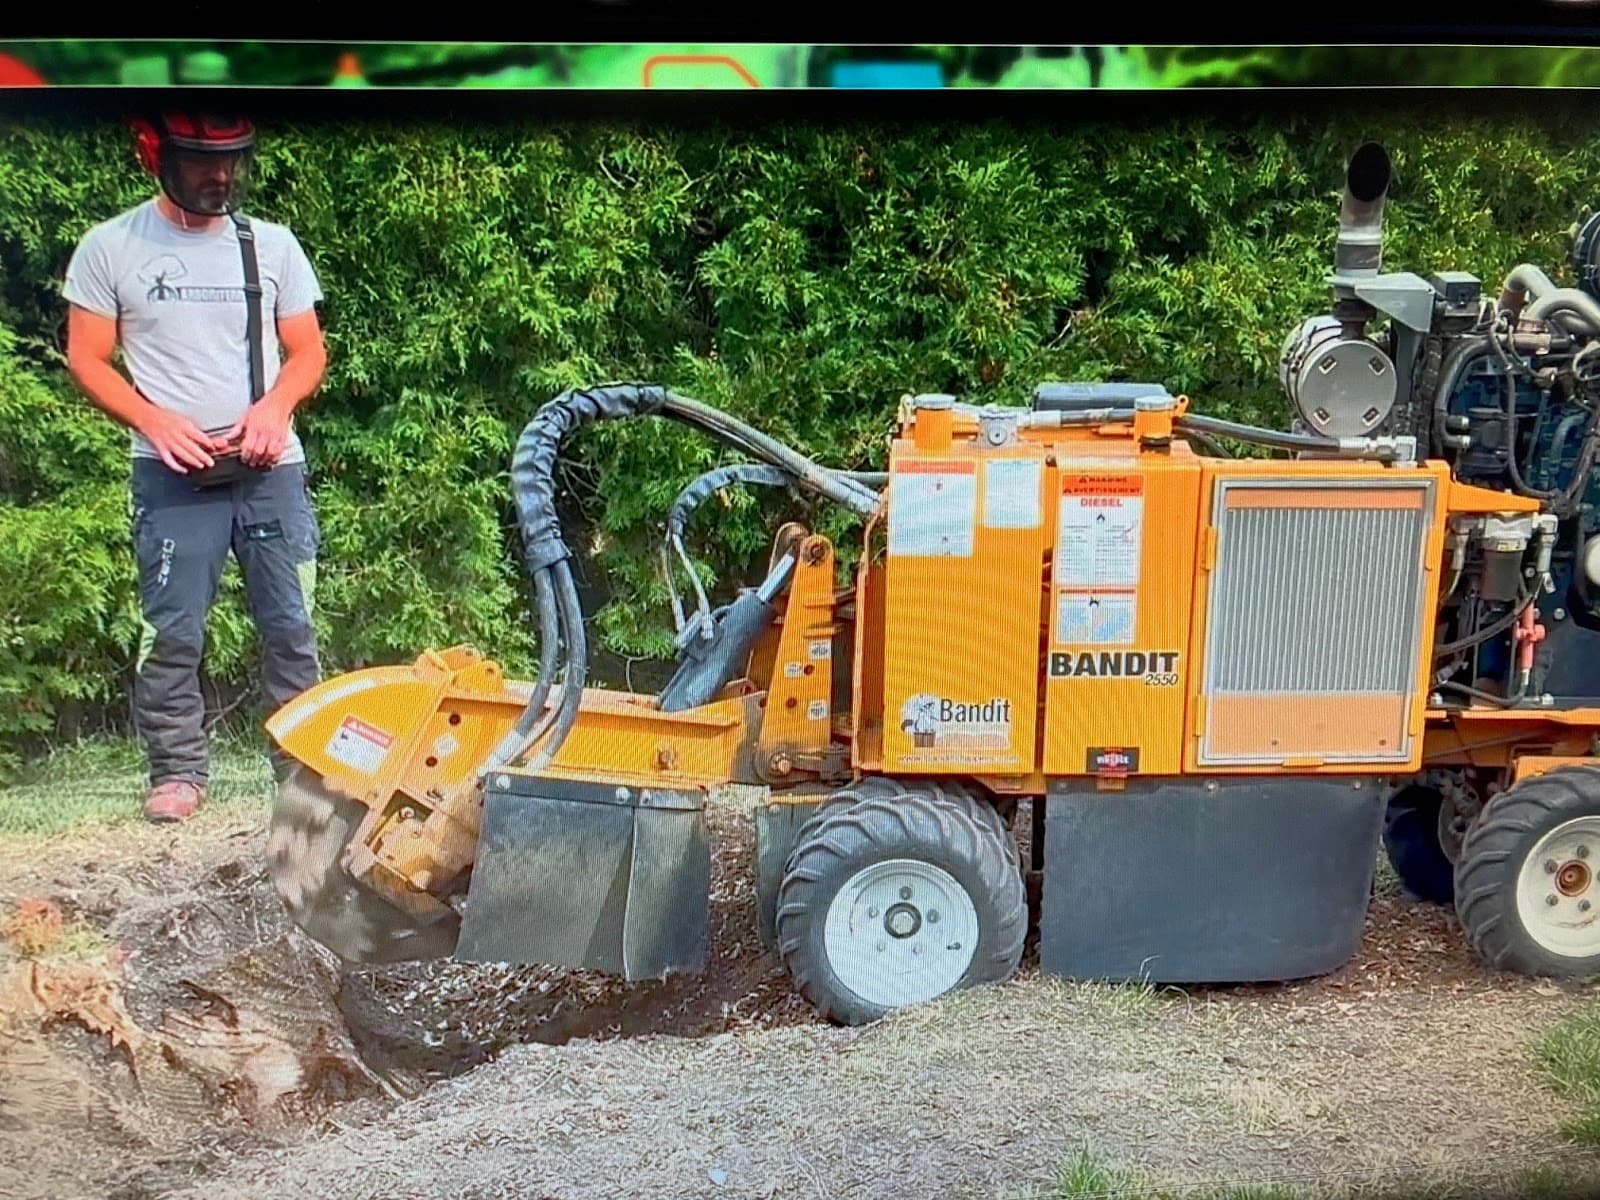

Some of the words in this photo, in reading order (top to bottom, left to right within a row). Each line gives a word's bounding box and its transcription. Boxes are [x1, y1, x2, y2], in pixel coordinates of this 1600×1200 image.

[1080, 498, 1123, 507] DIESEL
[1050, 652, 1179, 676] BANDIT
[1145, 673, 1179, 686] 2550
[940, 698, 1011, 723] Bandit
